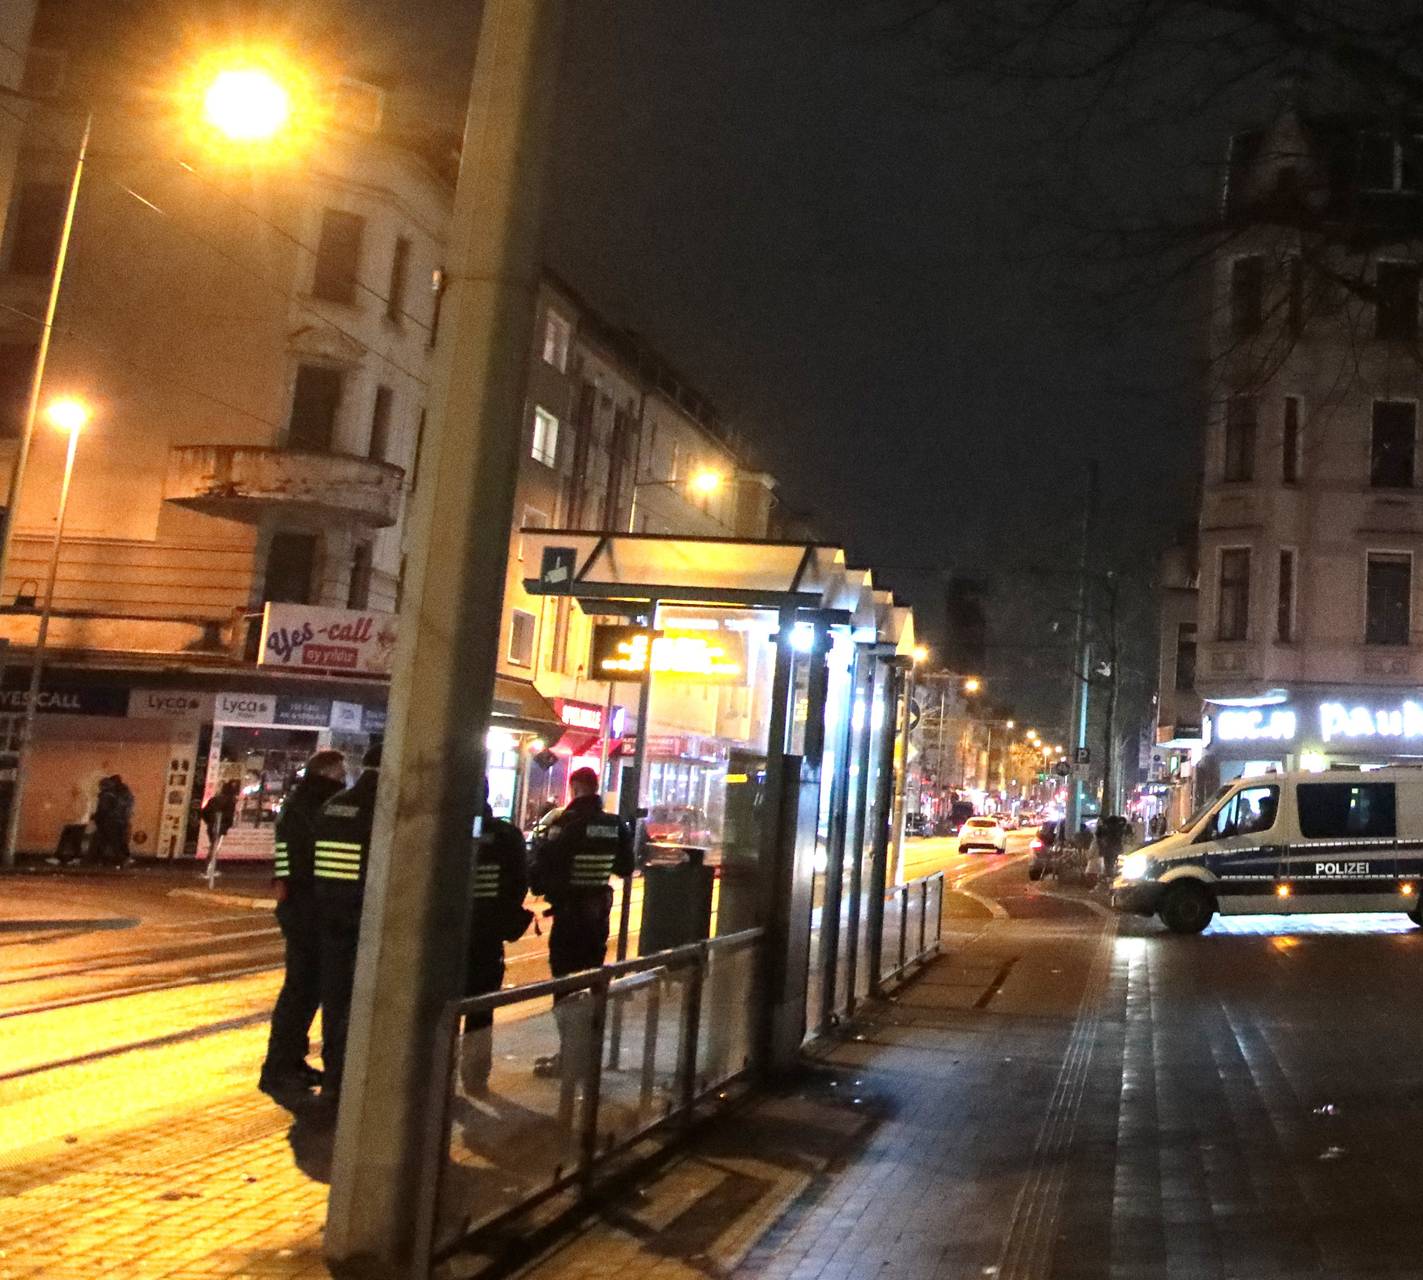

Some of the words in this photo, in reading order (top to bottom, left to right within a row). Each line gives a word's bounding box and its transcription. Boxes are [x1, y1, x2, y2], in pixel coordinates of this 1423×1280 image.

[38, 692, 81, 709] CALL
[148, 695, 187, 710] Lyca
[222, 696, 257, 713] Lyca
[1315, 862, 1369, 875] POLIZEI
